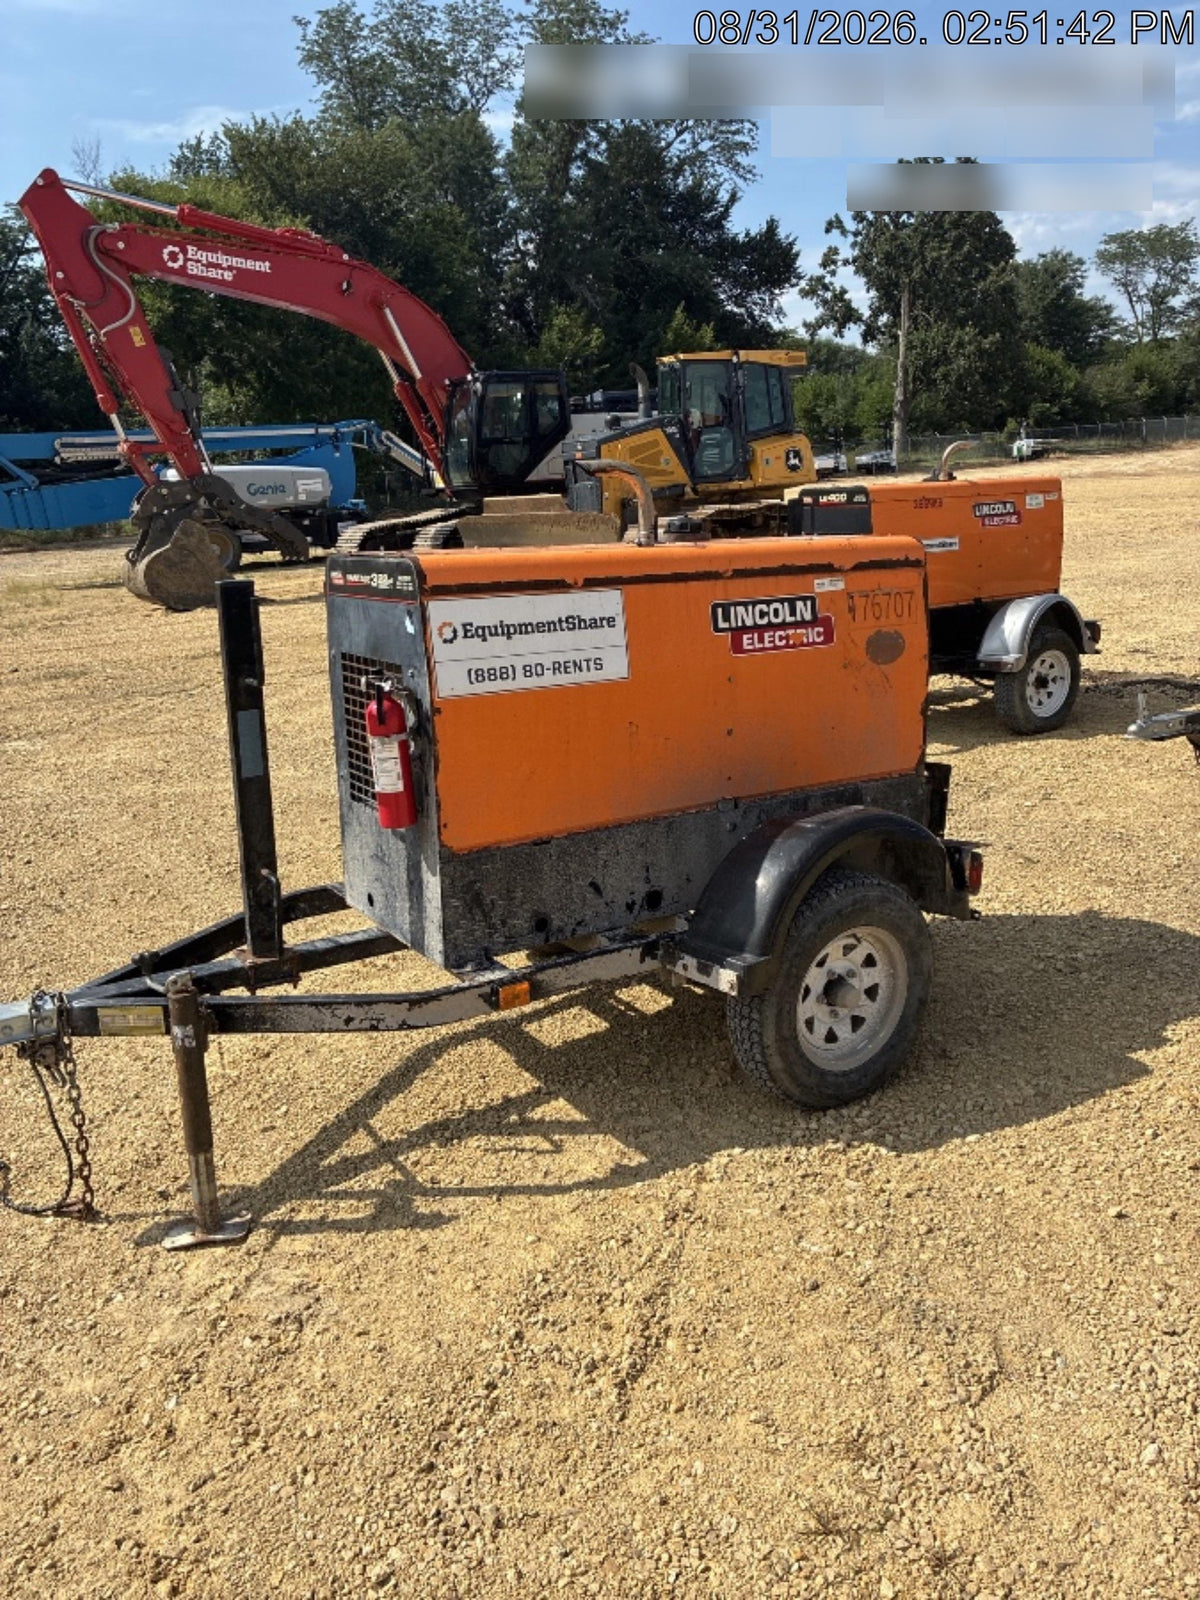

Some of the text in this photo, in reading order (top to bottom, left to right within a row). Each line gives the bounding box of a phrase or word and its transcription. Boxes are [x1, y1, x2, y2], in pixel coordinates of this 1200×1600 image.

[186, 245, 272, 273] Equipment
[246, 482, 287, 496] Genie
[716, 599, 813, 629] LINCOLN
[461, 614, 616, 643] EquipmentShare
[467, 657, 604, 685] (888) 80-RENTS
